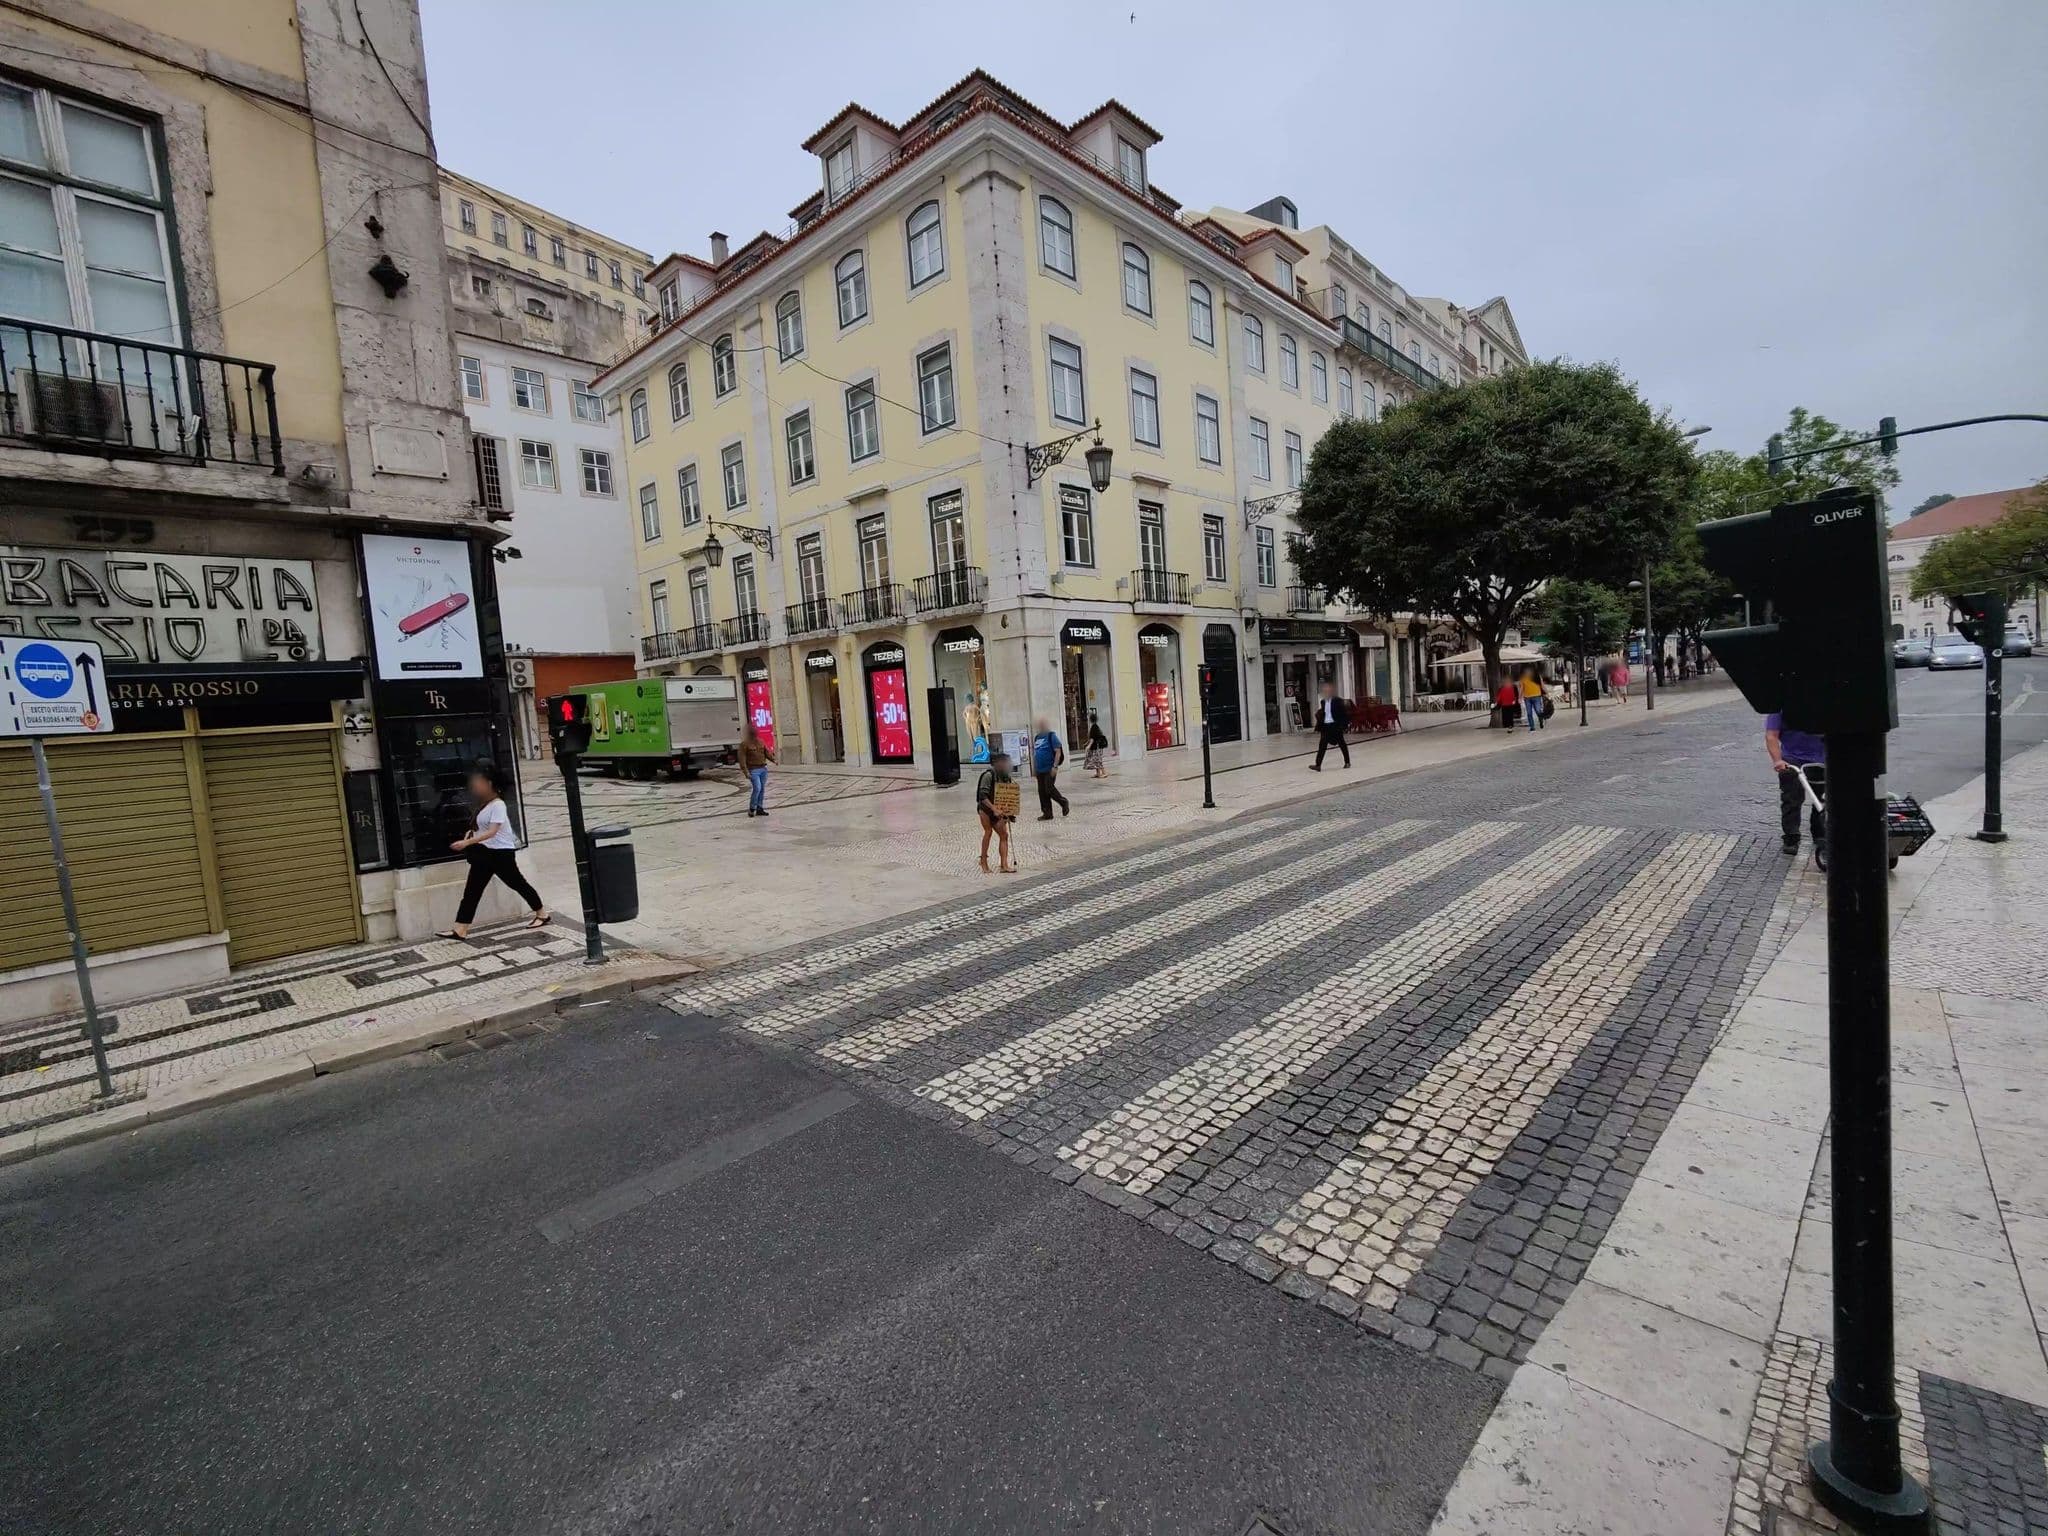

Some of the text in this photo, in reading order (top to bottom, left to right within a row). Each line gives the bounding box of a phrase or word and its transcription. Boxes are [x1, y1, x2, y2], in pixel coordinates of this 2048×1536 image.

[1814, 507, 1863, 524] OLIVER
[396, 556, 441, 565] VICTORINOX
[1069, 625, 1102, 637] TEZENIS
[944, 637, 980, 652] TEZENIS
[1140, 634, 1168, 645] TEZENIS
[807, 654, 834, 667] TEZENIS
[872, 648, 904, 662] TEZENIS
[172, 680, 259, 697] ROSSIO
[157, 698, 194, 706] 1931
[425, 690, 448, 709] TR
[30, 706, 52, 714] EXCETO
[880, 703, 907, 724] -50%
[26, 716, 42, 724] DUAS
[416, 736, 464, 746] CROSS
[352, 810, 373, 828] TR
